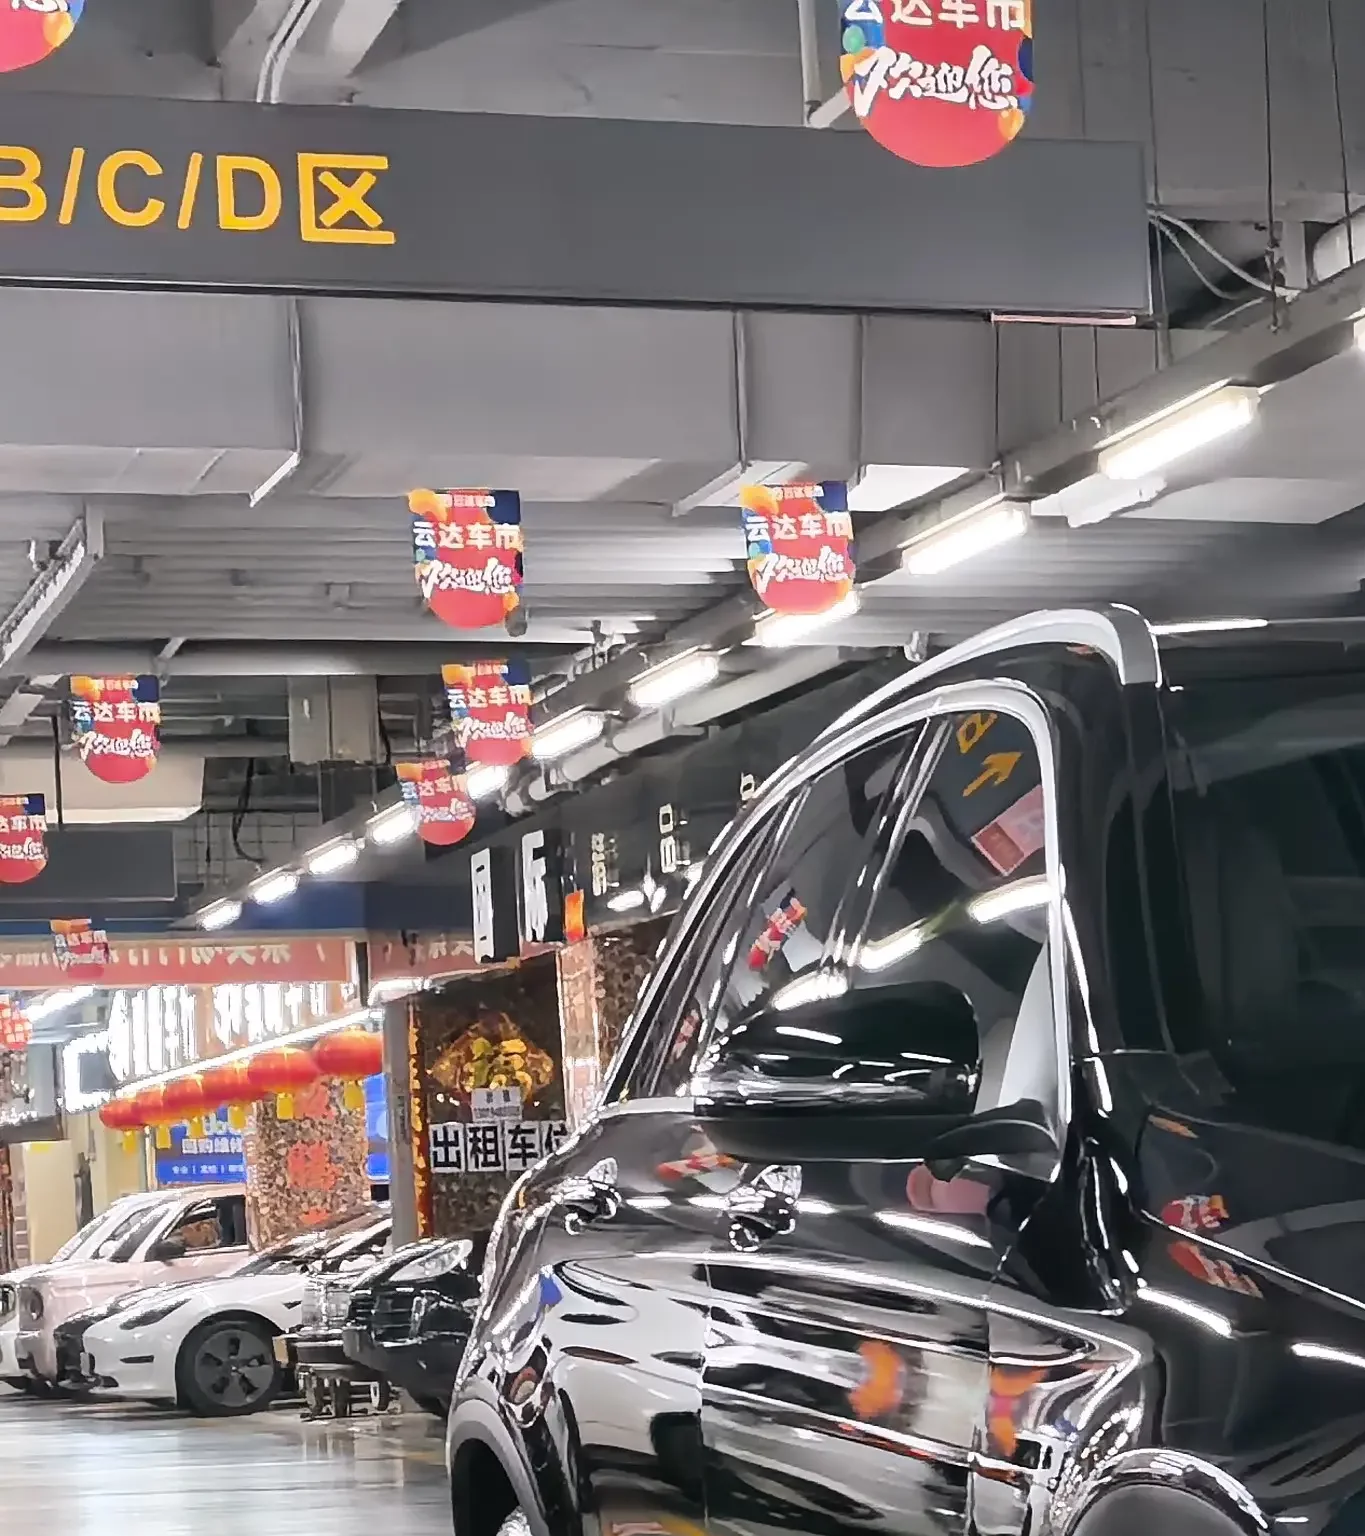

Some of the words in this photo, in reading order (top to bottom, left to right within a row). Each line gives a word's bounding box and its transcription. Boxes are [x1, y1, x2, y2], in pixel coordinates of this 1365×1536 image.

[412, 521, 524, 552] 云达车市
[744, 511, 855, 542] 云达车市
[72, 700, 162, 724] 云达车市
